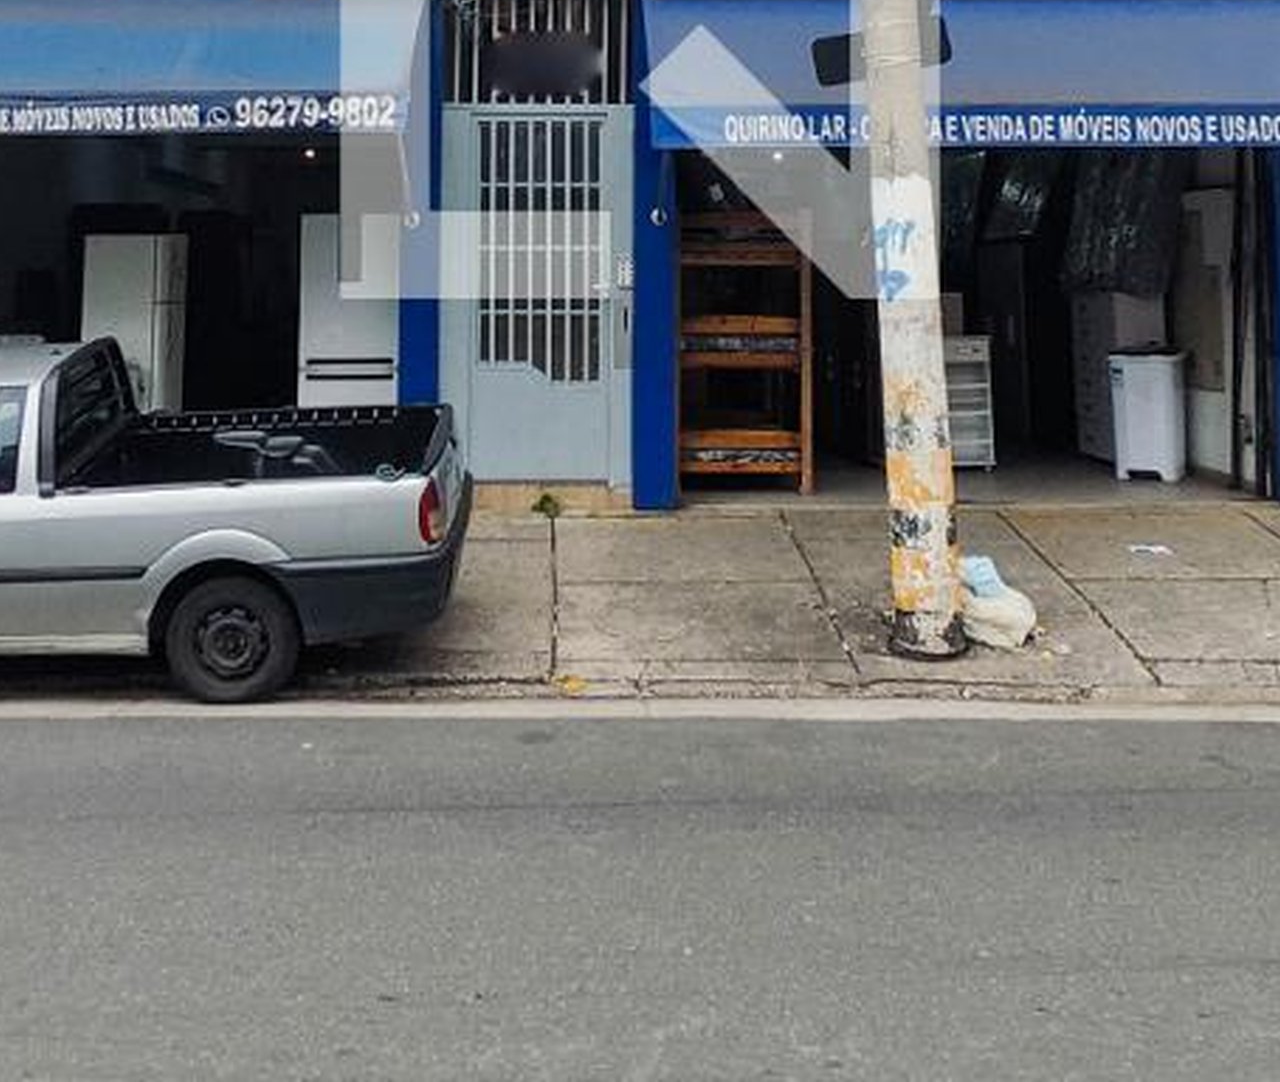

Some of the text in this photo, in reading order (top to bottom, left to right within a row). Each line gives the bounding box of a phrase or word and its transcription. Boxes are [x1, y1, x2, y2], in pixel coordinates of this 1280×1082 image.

[13, 101, 69, 132] MÓVEIS
[72, 106, 123, 132] NOVOS
[125, 106, 136, 131] E
[138, 105, 200, 131] USADOS
[235, 98, 397, 128] 96279-9802
[724, 114, 805, 142] QUIRINO
[811, 114, 846, 141] LAR
[945, 116, 957, 141] E
[961, 116, 1027, 141] VENDA
[1029, 116, 1055, 141] DE
[1059, 108, 1132, 142] MÓVEIS
[1135, 115, 1202, 142] NOVOS
[1206, 115, 1219, 141] E
